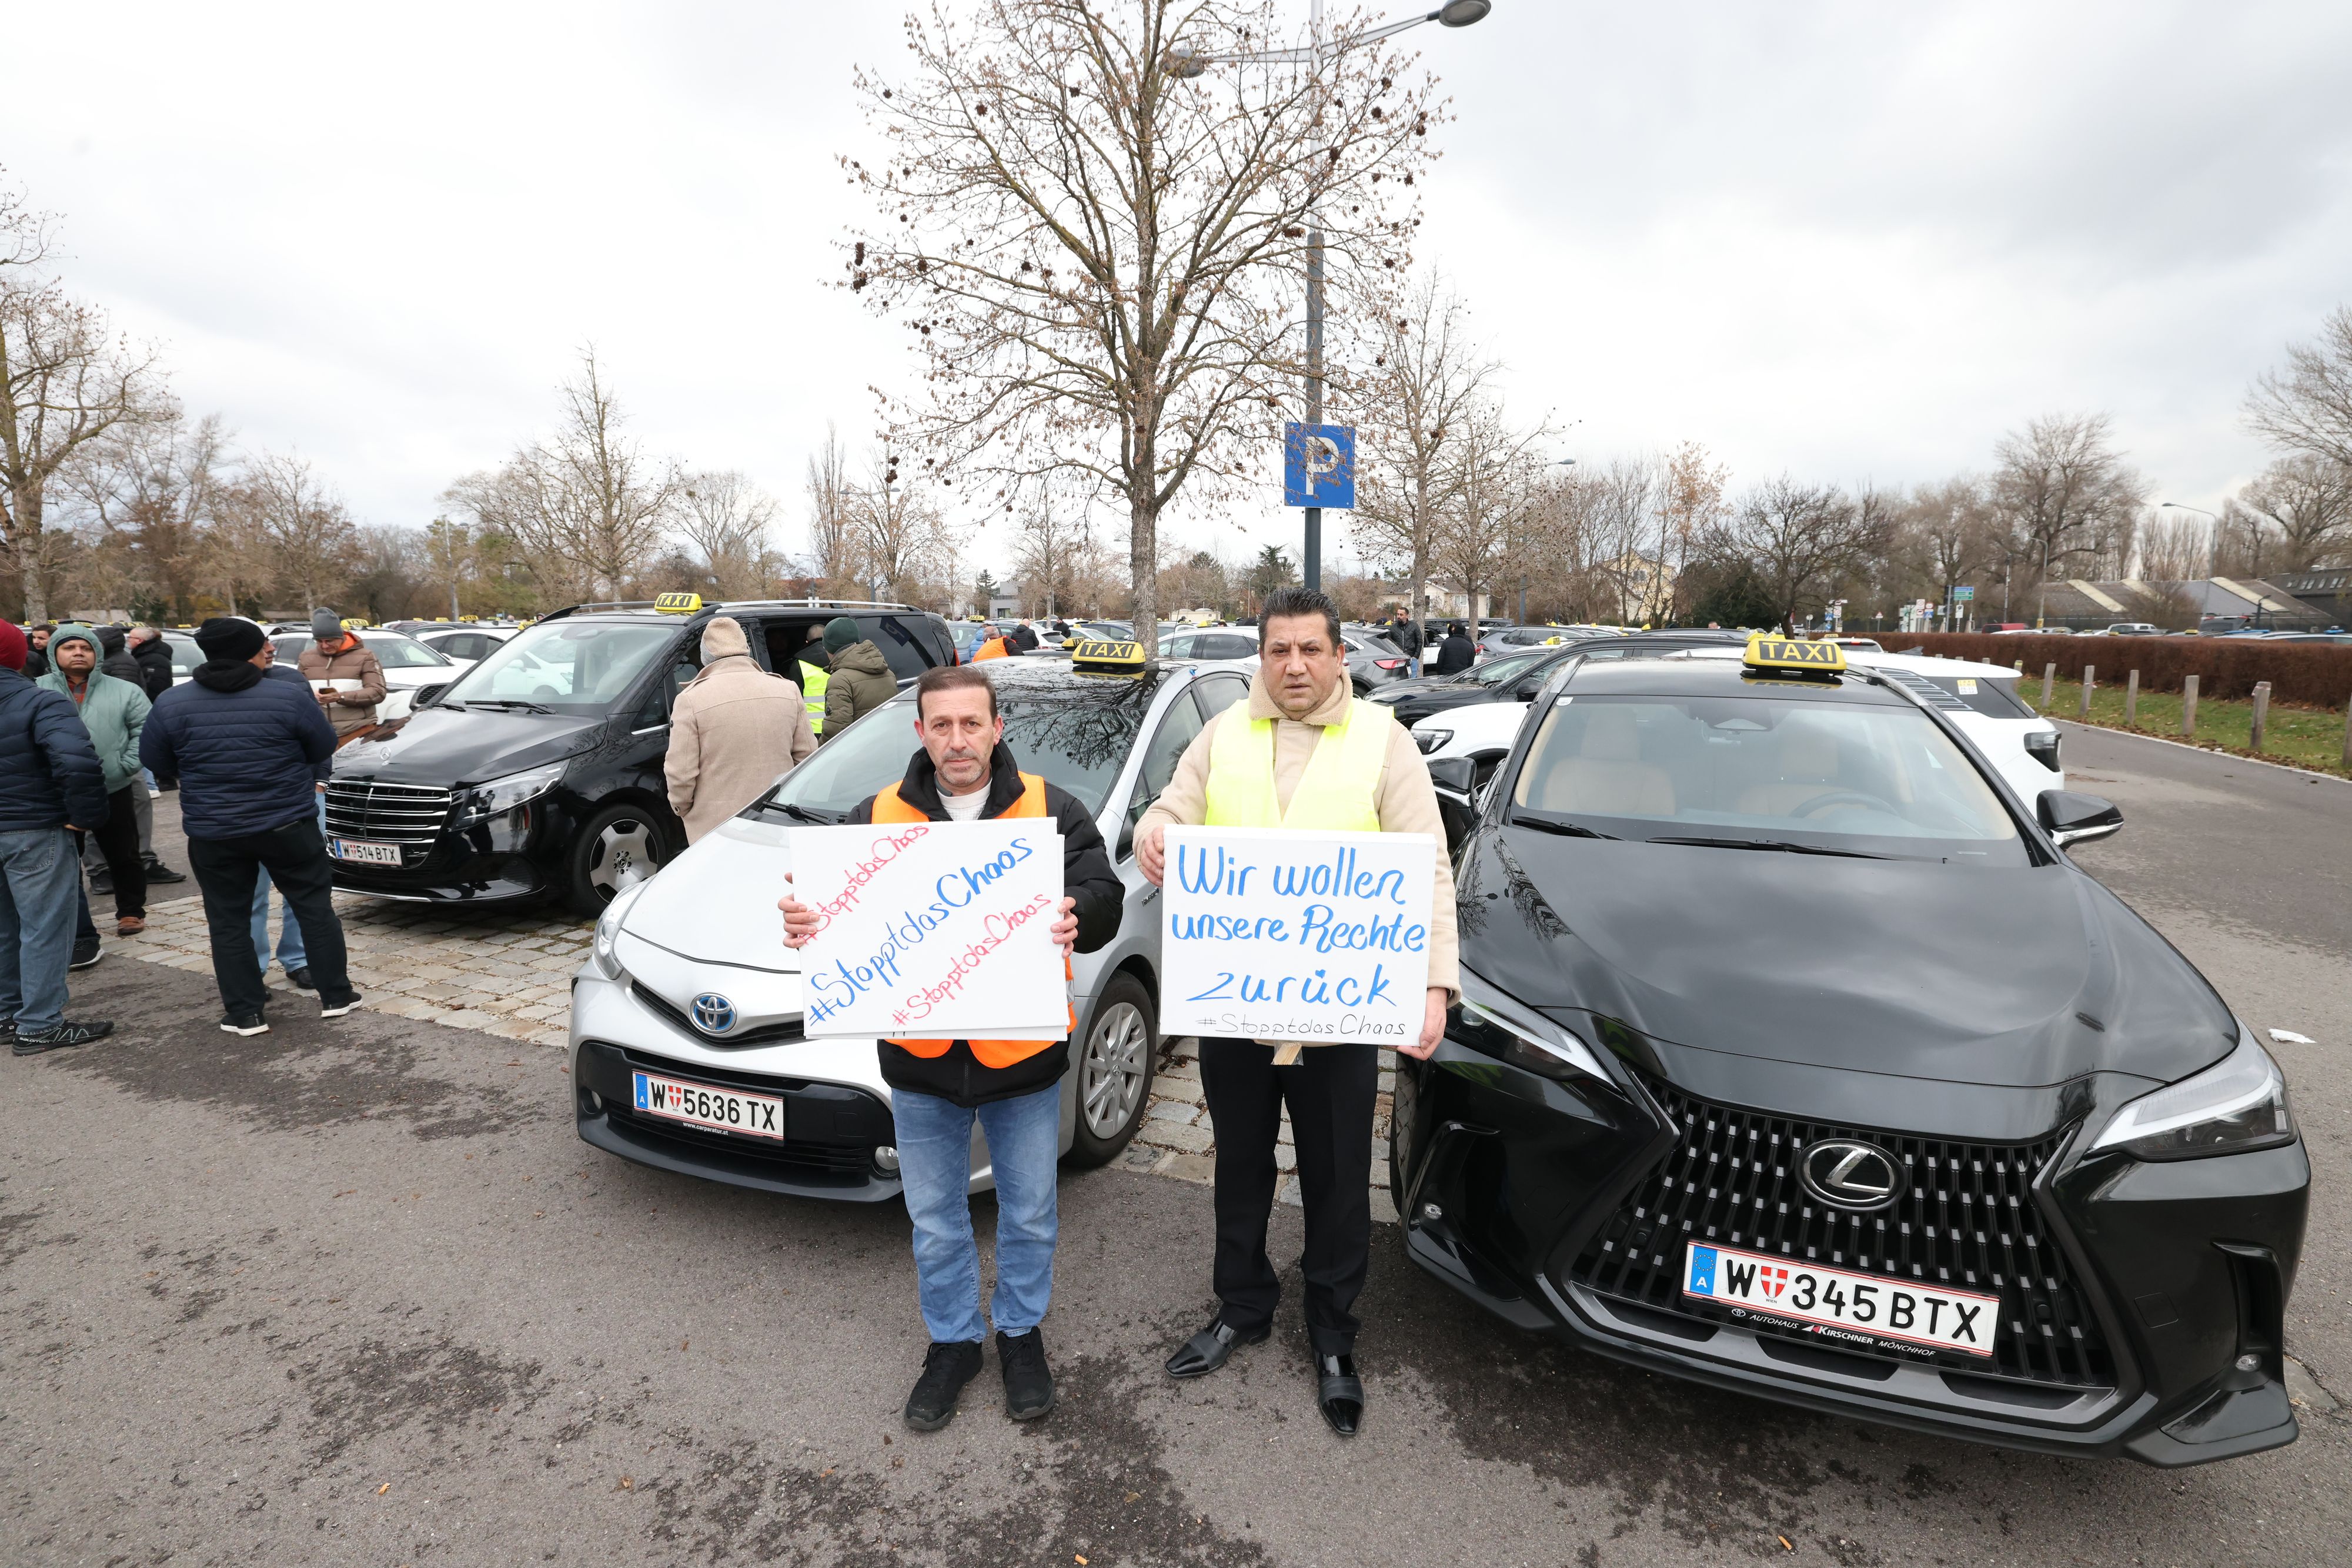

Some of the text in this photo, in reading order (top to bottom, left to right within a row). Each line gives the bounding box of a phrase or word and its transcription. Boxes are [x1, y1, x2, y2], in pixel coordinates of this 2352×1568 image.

[1306, 436, 1339, 496] P
[659, 596, 690, 606] TAXI
[1085, 643, 1132, 657] TAXI
[1762, 642, 1833, 661] TAXI
[342, 844, 350, 857] W
[1179, 844, 1406, 904] Wir wollen
[809, 838, 1033, 1026] #StopptdasChaos
[1172, 904, 1426, 953] unsere Rechte
[892, 894, 1051, 1026] #StopptdasChaos
[651, 1082, 666, 1109] W
[684, 1089, 740, 1124] 5636
[683, 1122, 729, 1135] www.carparatur.at
[1696, 1276, 1707, 1288] A
[1726, 1259, 1756, 1298] W
[1750, 1315, 1936, 1356] AUTOHAUS KIRSCHNER MÖNCHHOF
